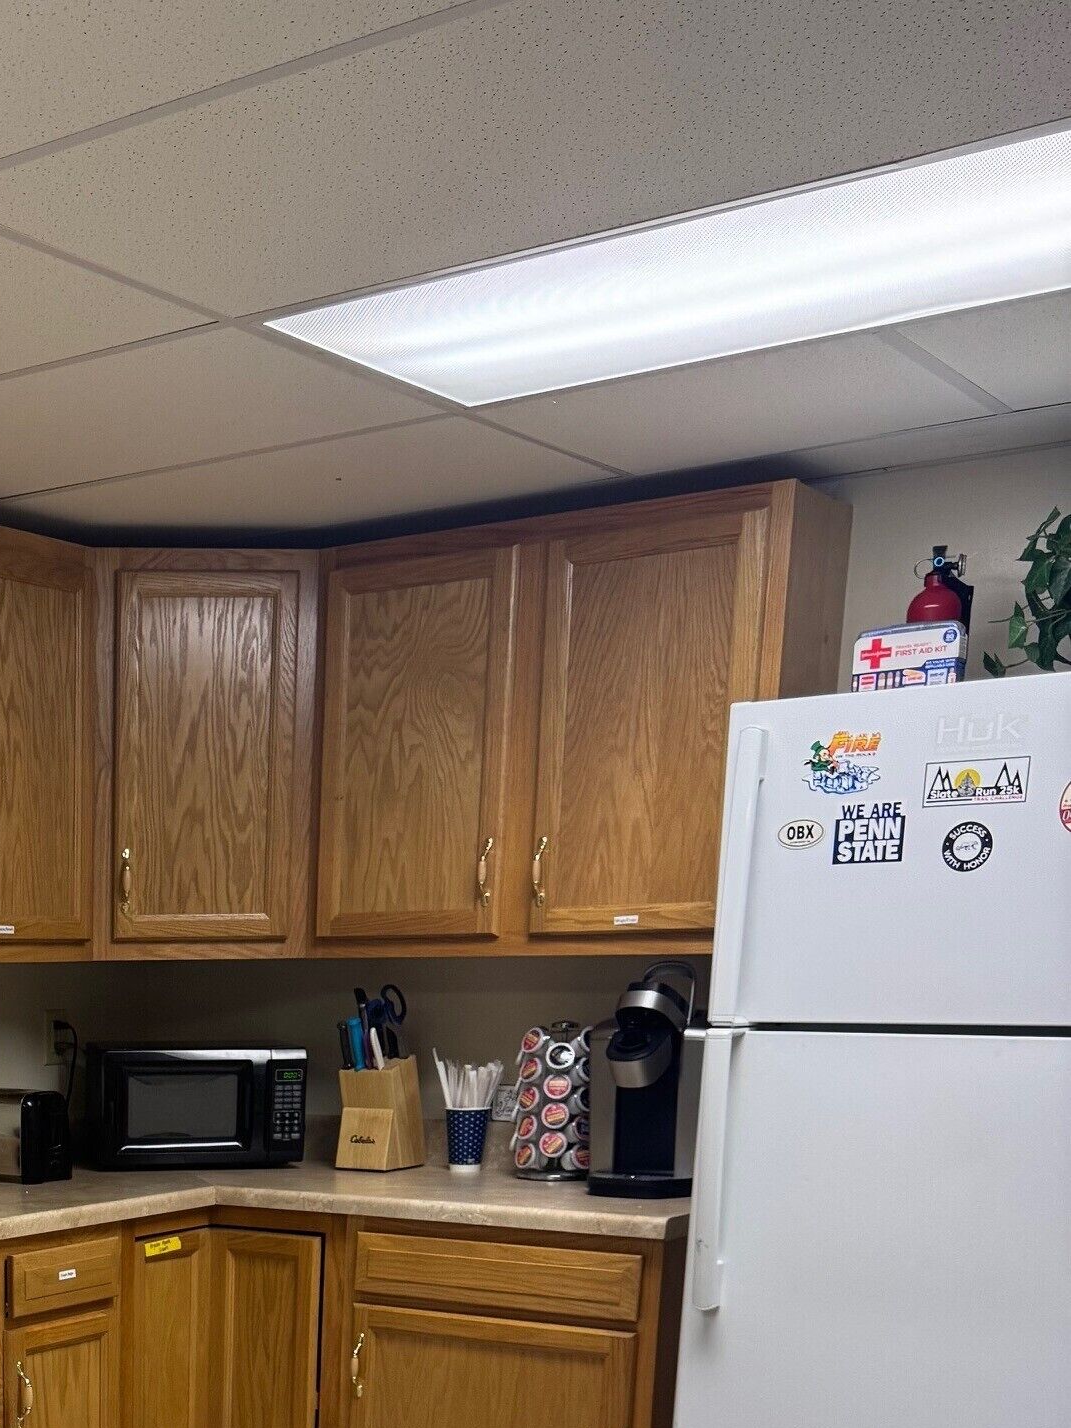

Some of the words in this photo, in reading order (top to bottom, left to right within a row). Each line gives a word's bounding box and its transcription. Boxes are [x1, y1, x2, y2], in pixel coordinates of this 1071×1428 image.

[895, 648, 918, 658] FIRST
[919, 646, 933, 655] AID
[934, 644, 948, 653] KIT
[929, 789, 959, 800] Slate
[975, 787, 997, 797] Run
[999, 785, 1020, 795] 25k
[842, 804, 865, 819] WE
[870, 802, 902, 818] ARE
[787, 825, 814, 840] OBX
[838, 817, 902, 842] PENN
[949, 824, 987, 840] SUCCESS
[837, 839, 900, 862] STATE
[944, 849, 960, 869] WITH
[963, 847, 991, 870] HONOR
